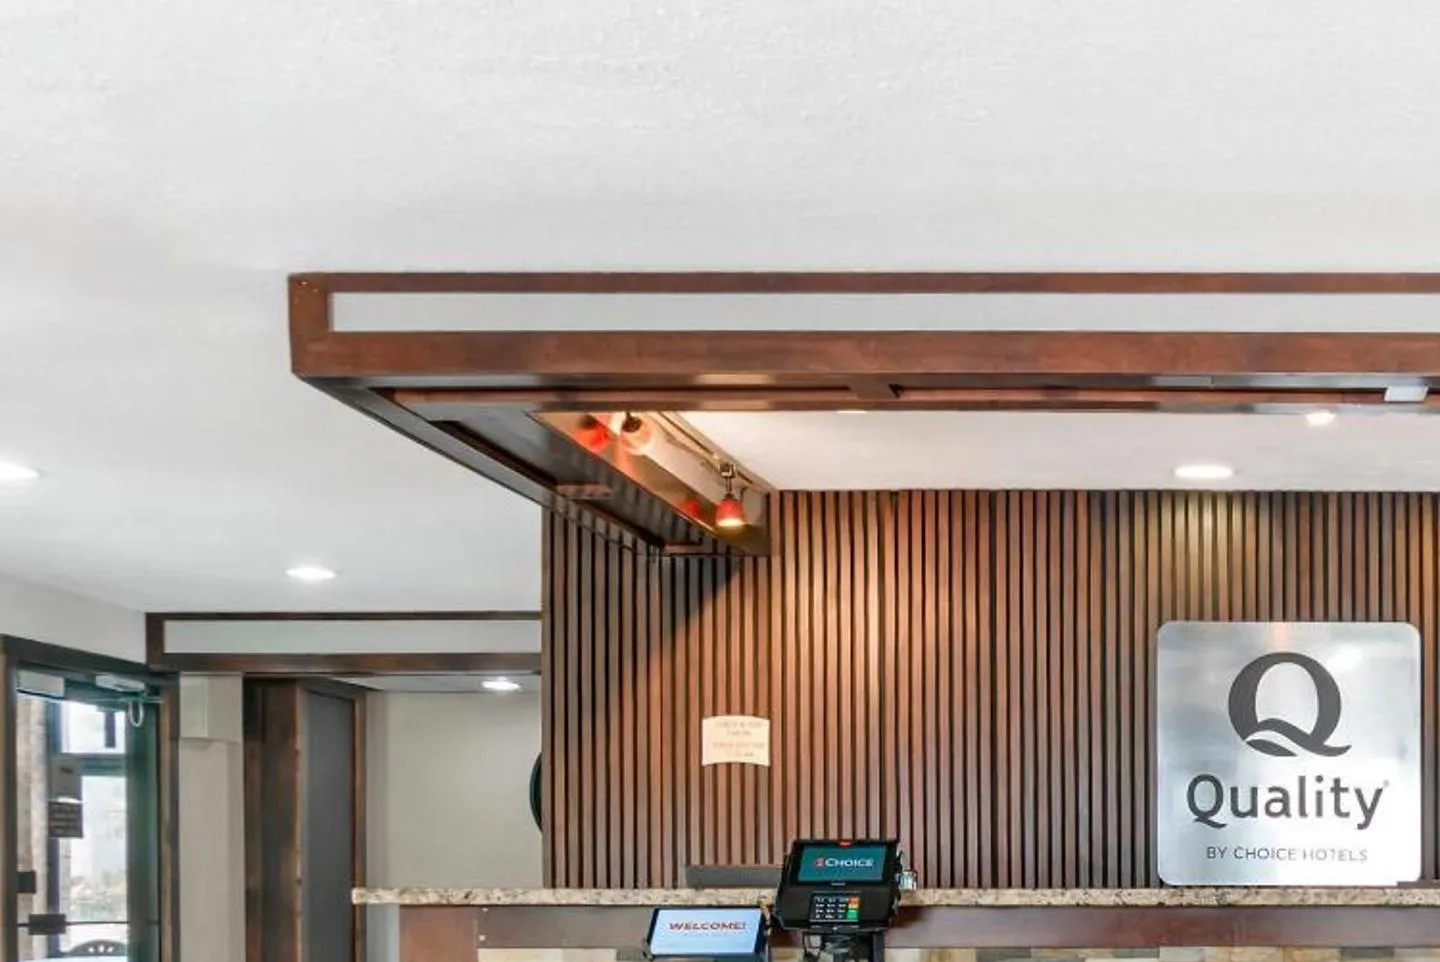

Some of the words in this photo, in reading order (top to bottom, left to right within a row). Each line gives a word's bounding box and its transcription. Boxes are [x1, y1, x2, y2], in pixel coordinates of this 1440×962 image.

[1228, 651, 1352, 757] Q
[1186, 773, 1385, 830] Quality
[825, 857, 875, 868] CHOICE
[1206, 846, 1228, 860] BY
[1234, 846, 1297, 861] CHOICE
[1302, 848, 1368, 863] HOTELS
[669, 921, 747, 931] WELCOME!
